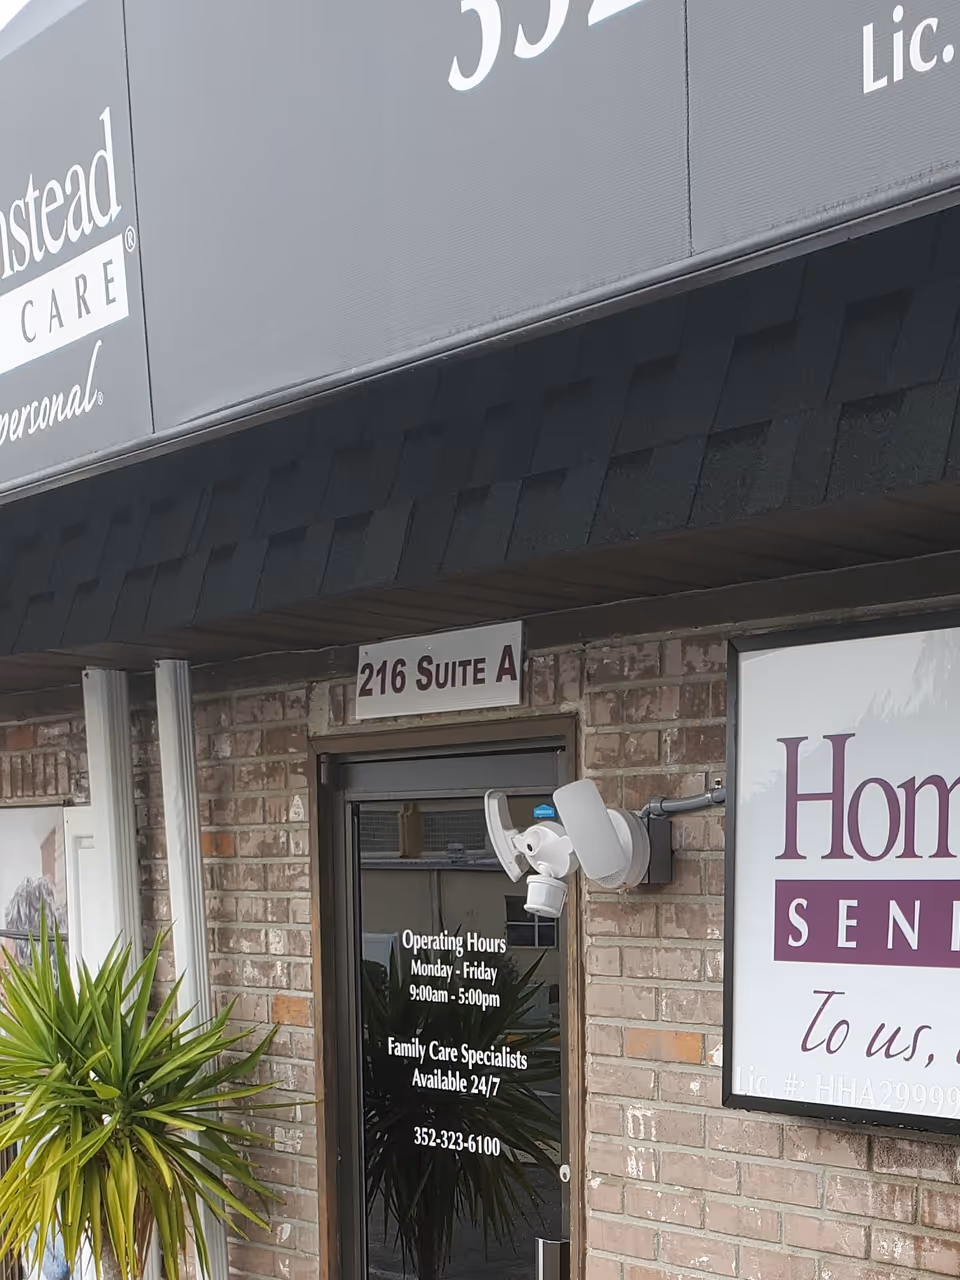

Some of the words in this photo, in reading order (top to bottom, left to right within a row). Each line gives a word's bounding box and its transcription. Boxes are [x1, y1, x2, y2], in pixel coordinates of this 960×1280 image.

[863, 5, 954, 94] Lic.
[20, 259, 117, 343] CARE
[358, 658, 407, 697] 216
[416, 655, 486, 691] SUITE
[496, 644, 518, 683] A
[402, 929, 463, 957] Operating
[467, 932, 507, 953] Hours
[411, 958, 453, 983] Monday
[463, 961, 498, 986] Friday
[409, 984, 448, 1003] 9:00am
[458, 987, 500, 1011] 5:00pm
[801, 990, 848, 1055] To
[865, 1024, 935, 1068] us,
[388, 1036, 426, 1064] Family
[429, 1040, 458, 1062] Care
[461, 1043, 528, 1070] Specialists
[412, 1067, 467, 1092] Available
[470, 1074, 500, 1098] 24/7
[414, 1126, 500, 1156] 352-323-6100
